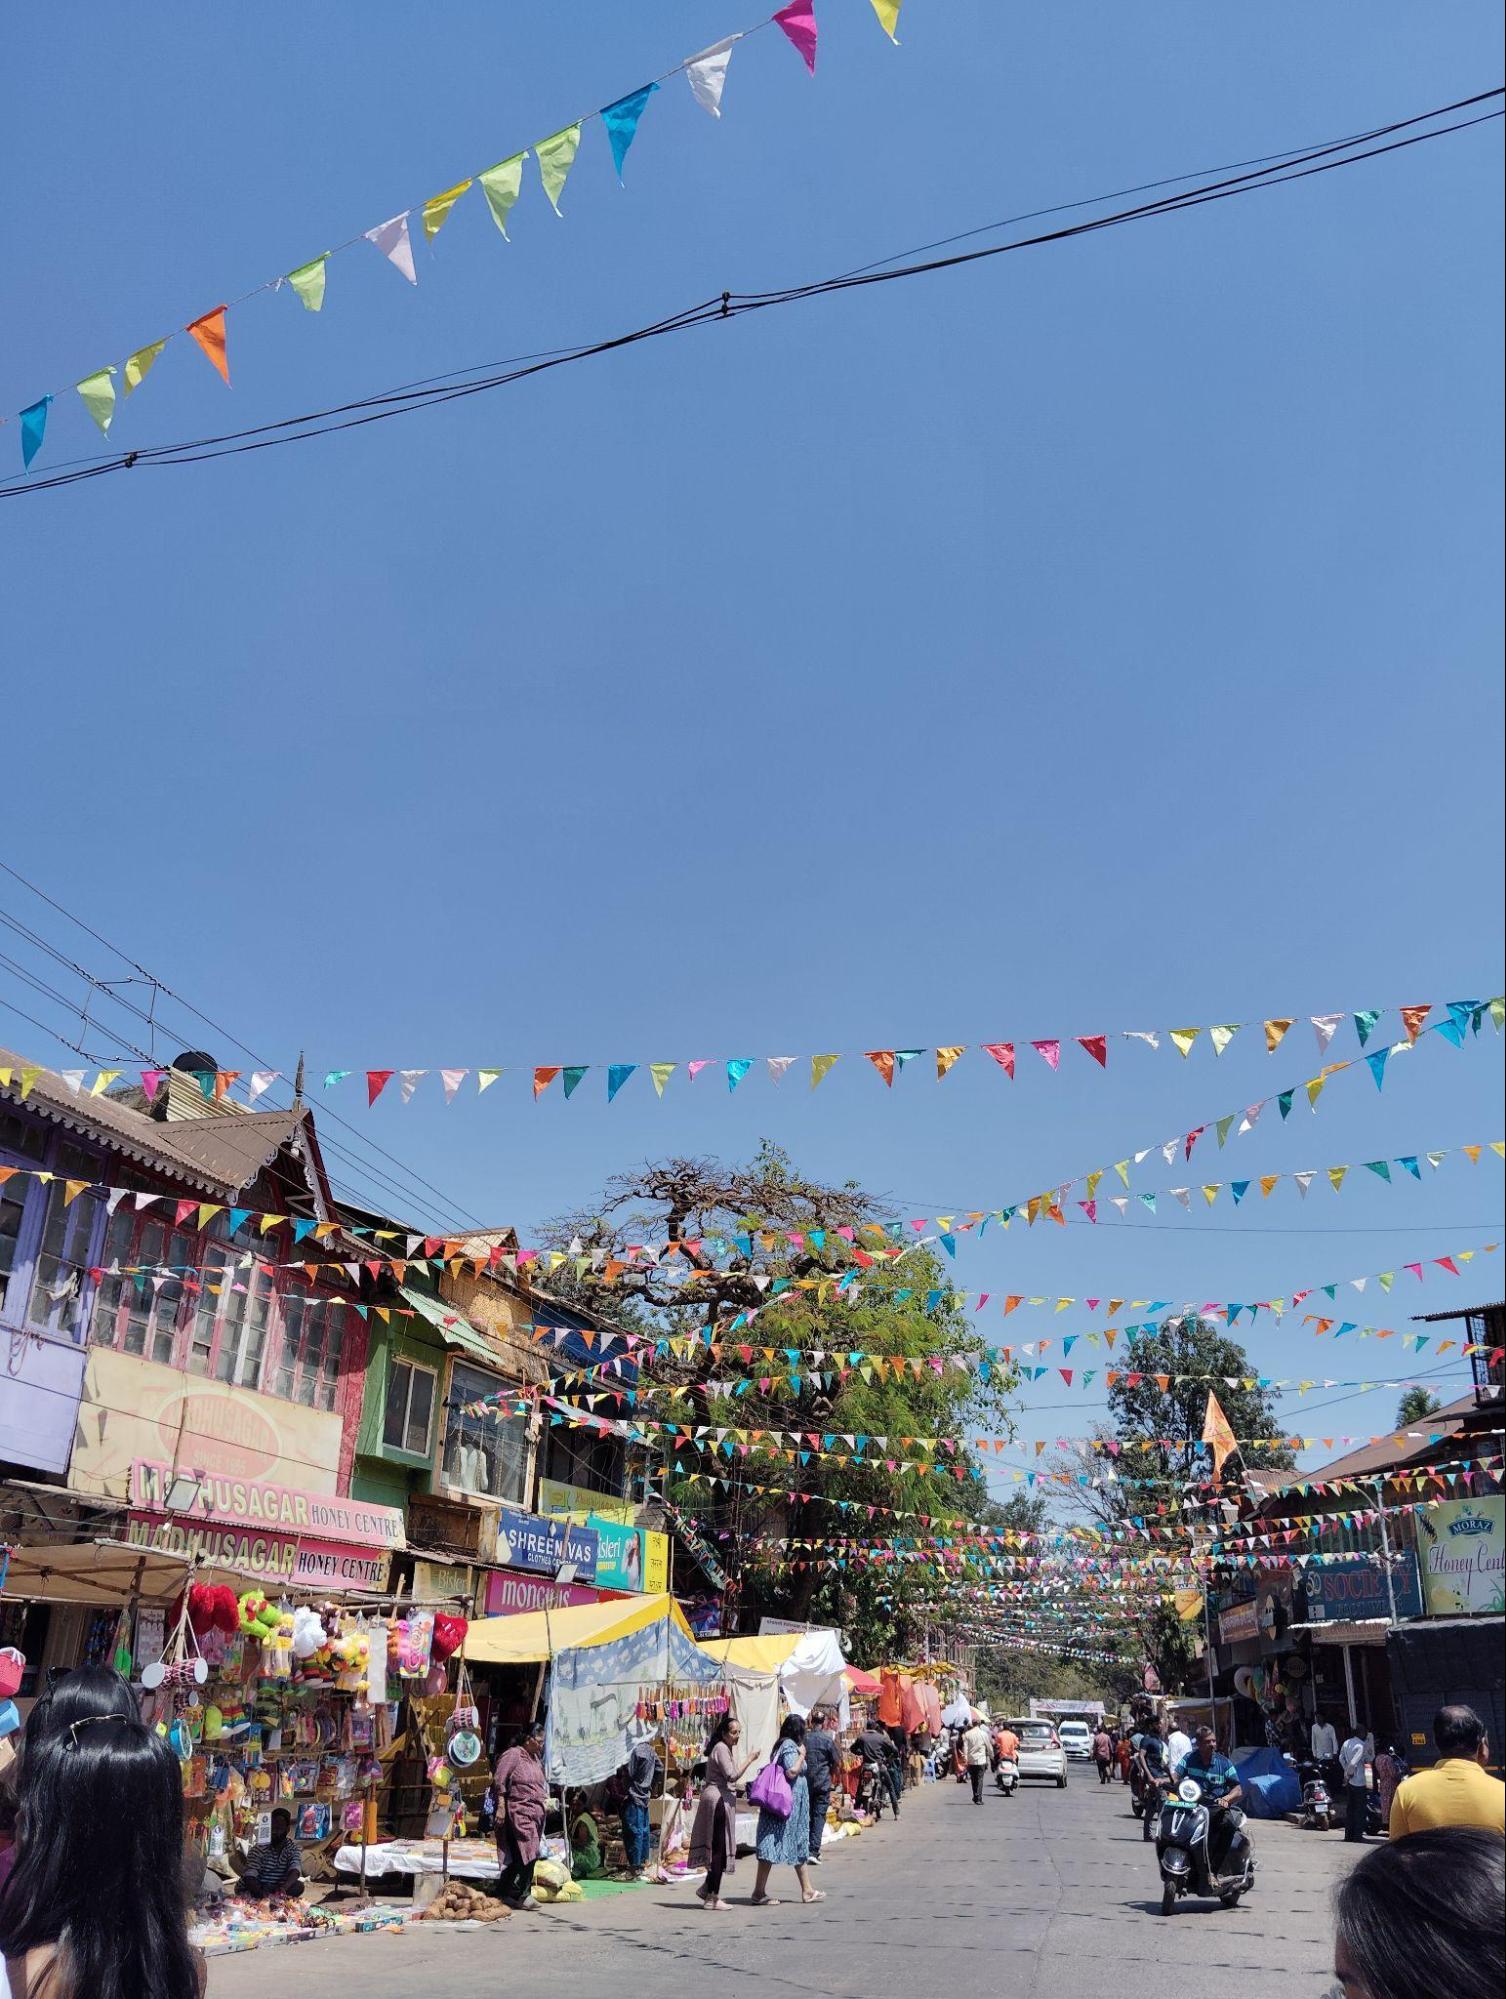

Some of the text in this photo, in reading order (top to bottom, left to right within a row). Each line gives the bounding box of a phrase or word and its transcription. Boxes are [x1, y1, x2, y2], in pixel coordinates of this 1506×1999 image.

[139, 1465, 399, 1538] MHUSAGAR HONEY CENTRE
[508, 1529, 592, 1563] SHREENVAS
[598, 1534, 622, 1559] isleri
[298, 1552, 338, 1576] HONEY
[341, 1559, 384, 1582] CENTRE
[1323, 1564, 1412, 1602] SOCIEY
[1429, 1543, 1473, 1596] Honey
